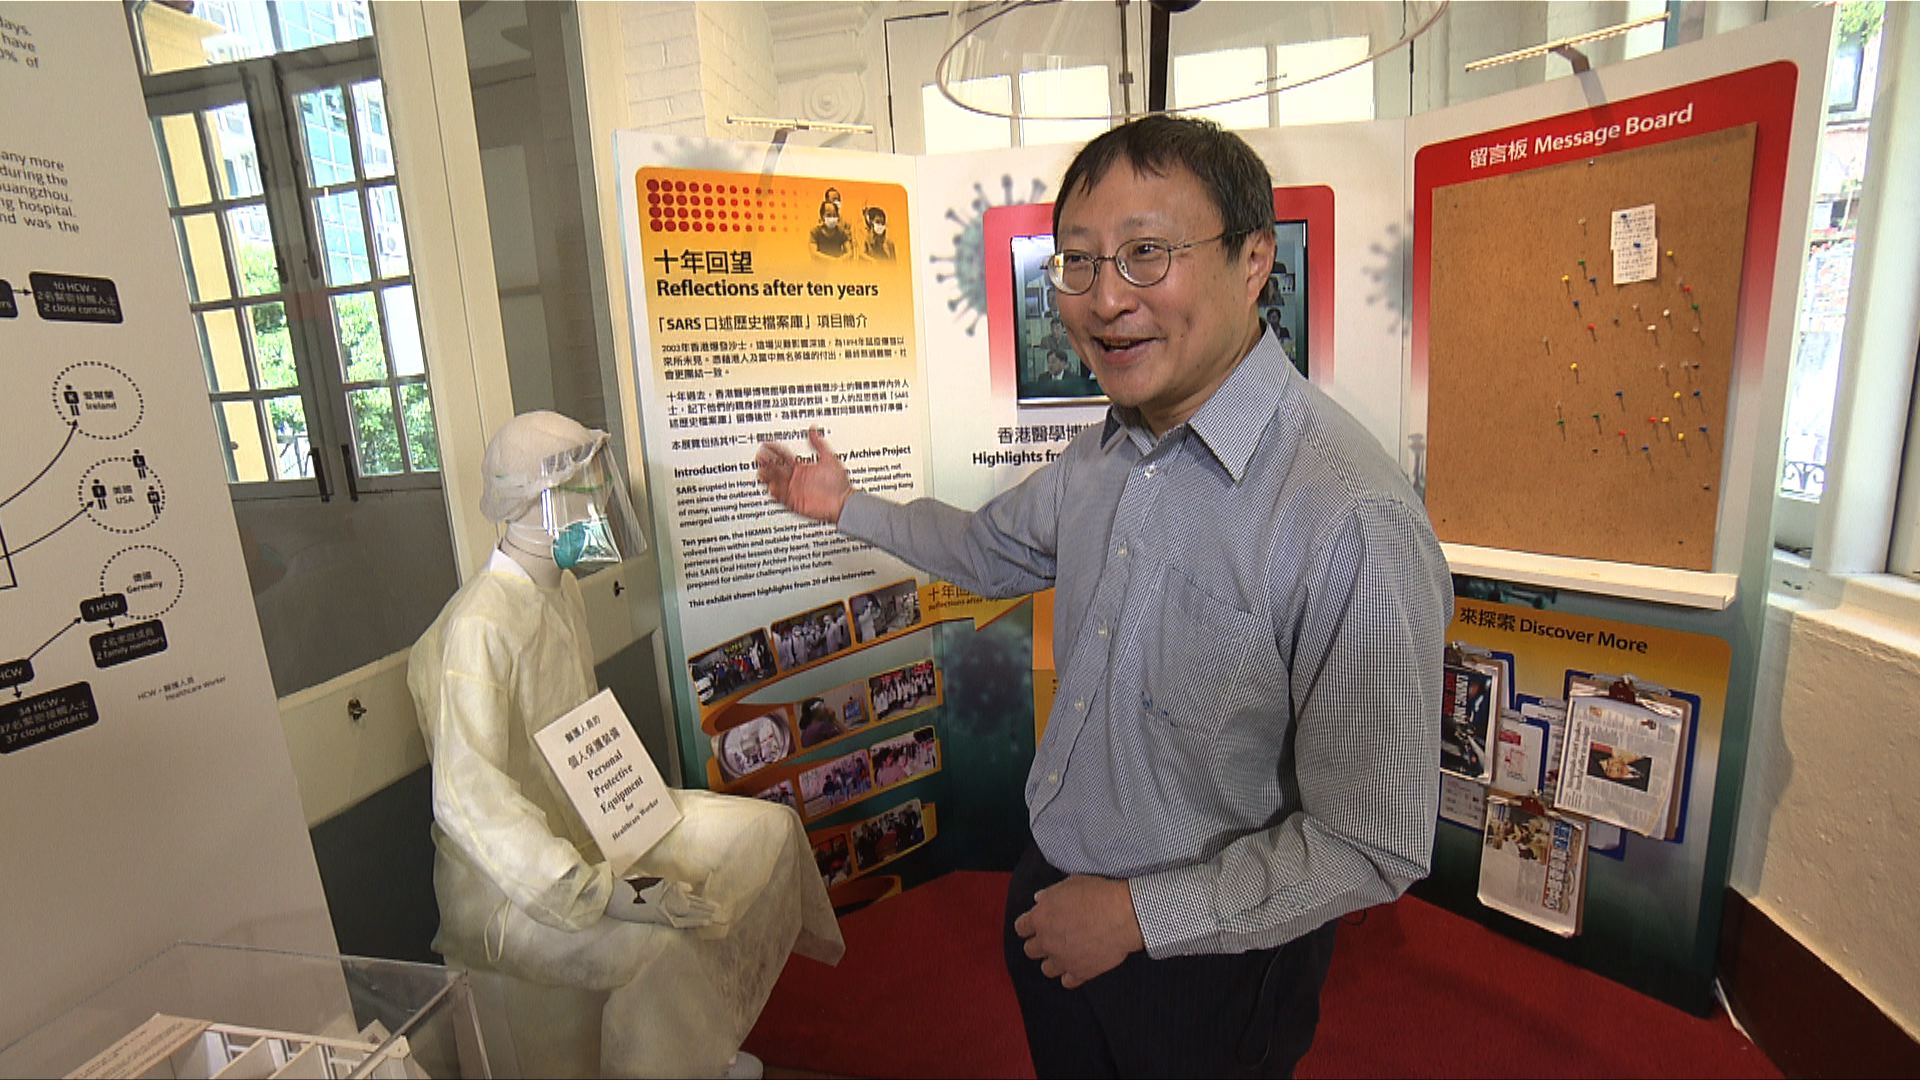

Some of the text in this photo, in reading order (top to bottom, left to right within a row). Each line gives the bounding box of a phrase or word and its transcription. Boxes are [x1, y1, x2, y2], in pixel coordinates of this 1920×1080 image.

[1, 32, 36, 52] have
[26, 56, 39, 68] of
[1469, 103, 1693, 169] 留言板 Message Board
[30, 157, 64, 172] more
[0, 165, 68, 186] during the
[0, 183, 72, 202] uangzhou.
[18, 198, 77, 217] hospital.
[23, 217, 52, 230] was
[58, 221, 79, 233] the
[654, 249, 754, 275] 十年回望
[66, 282, 90, 292] HCW
[656, 279, 879, 300] Reflections after ten years
[52, 303, 76, 313] close
[79, 305, 116, 316] contacts
[85, 401, 117, 410] Ireland
[796, 455, 814, 464] Oral
[850, 448, 881, 459] Archive
[882, 445, 911, 457] Project
[973, 450, 1043, 467] Highlights
[674, 463, 737, 478] Introduction
[739, 462, 750, 470] to
[676, 485, 697, 495] SARS
[699, 481, 727, 493] erupted
[737, 479, 756, 489] Hong
[115, 495, 135, 504] USA
[696, 495, 714, 504] since
[716, 493, 728, 501] the
[729, 489, 761, 499] outbreak
[679, 509, 686, 517] of
[711, 503, 738, 513] unsung
[739, 499, 762, 508] heroes
[680, 517, 713, 528] emerged
[714, 514, 729, 523] with
[737, 510, 765, 520] stronger
[681, 538, 696, 547] Ten
[698, 536, 718, 546] years
[732, 531, 743, 539] the
[773, 524, 797, 535] Society
[709, 545, 726, 554] from
[727, 542, 749, 551] within
[765, 536, 789, 545] outside
[803, 530, 823, 539] health
[720, 555, 734, 563] and
[748, 549, 773, 558] lessons
[774, 546, 788, 555] they
[700, 568, 719, 577] SARS
[720, 564, 735, 573] Oral
[736, 561, 761, 572] History
[762, 557, 787, 567] Archive
[789, 552, 811, 562] Project
[126, 581, 163, 593] Germany
[687, 578, 720, 591] prepared
[721, 575, 731, 584] for
[732, 572, 754, 582] similar
[756, 565, 792, 579] challenges
[689, 599, 705, 608] This
[706, 595, 732, 605] exhibit
[734, 590, 756, 600] shows
[757, 583, 793, 597] highlights
[794, 580, 811, 589] from
[96, 601, 118, 611] HCW
[1460, 607, 1648, 654] 來探索 Discover More
[33, 698, 58, 711] HCW
[6, 712, 89, 743] 37 close contacts
[587, 749, 623, 781] Personal
[594, 764, 633, 798] Protective
[600, 776, 644, 814] Equipment
[625, 803, 634, 813] for
[612, 798, 659, 841] Healthcare Worker
